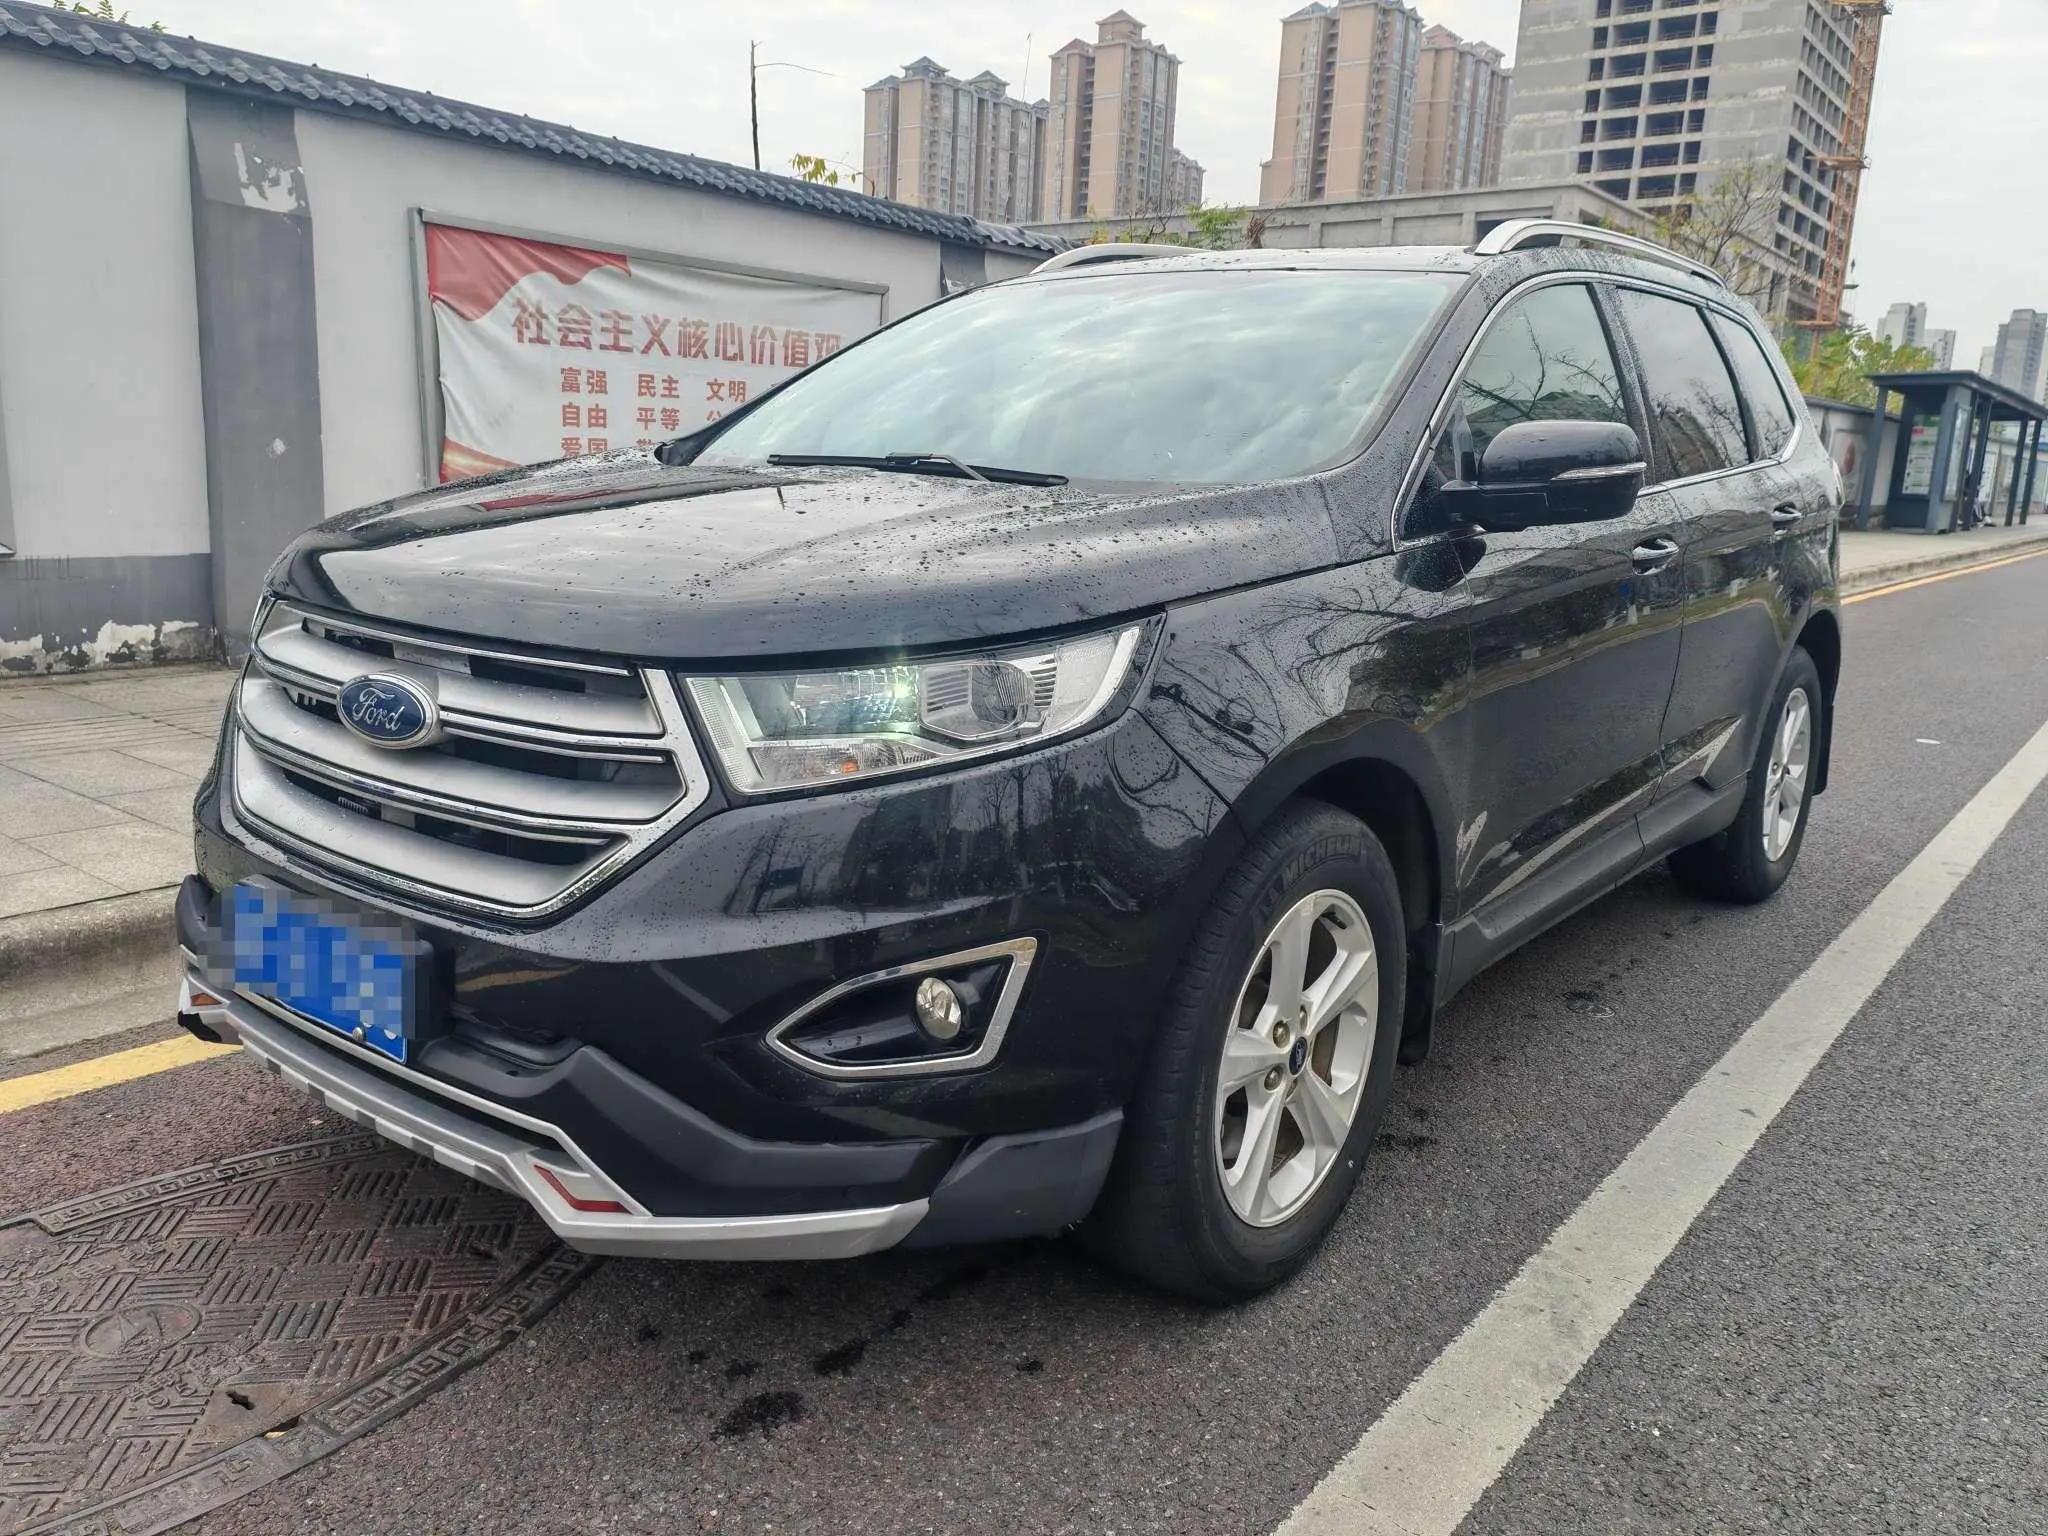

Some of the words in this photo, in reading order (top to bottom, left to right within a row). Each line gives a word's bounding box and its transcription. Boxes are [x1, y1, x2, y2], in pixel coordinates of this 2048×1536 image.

[512, 296, 842, 368] 社会主义核心价值观
[560, 366, 608, 395] 富强
[637, 373, 680, 399] 民主
[706, 378, 747, 402] 文明
[562, 401, 608, 429] 自由
[636, 407, 680, 432] 平等
[352, 687, 405, 731] Ford
